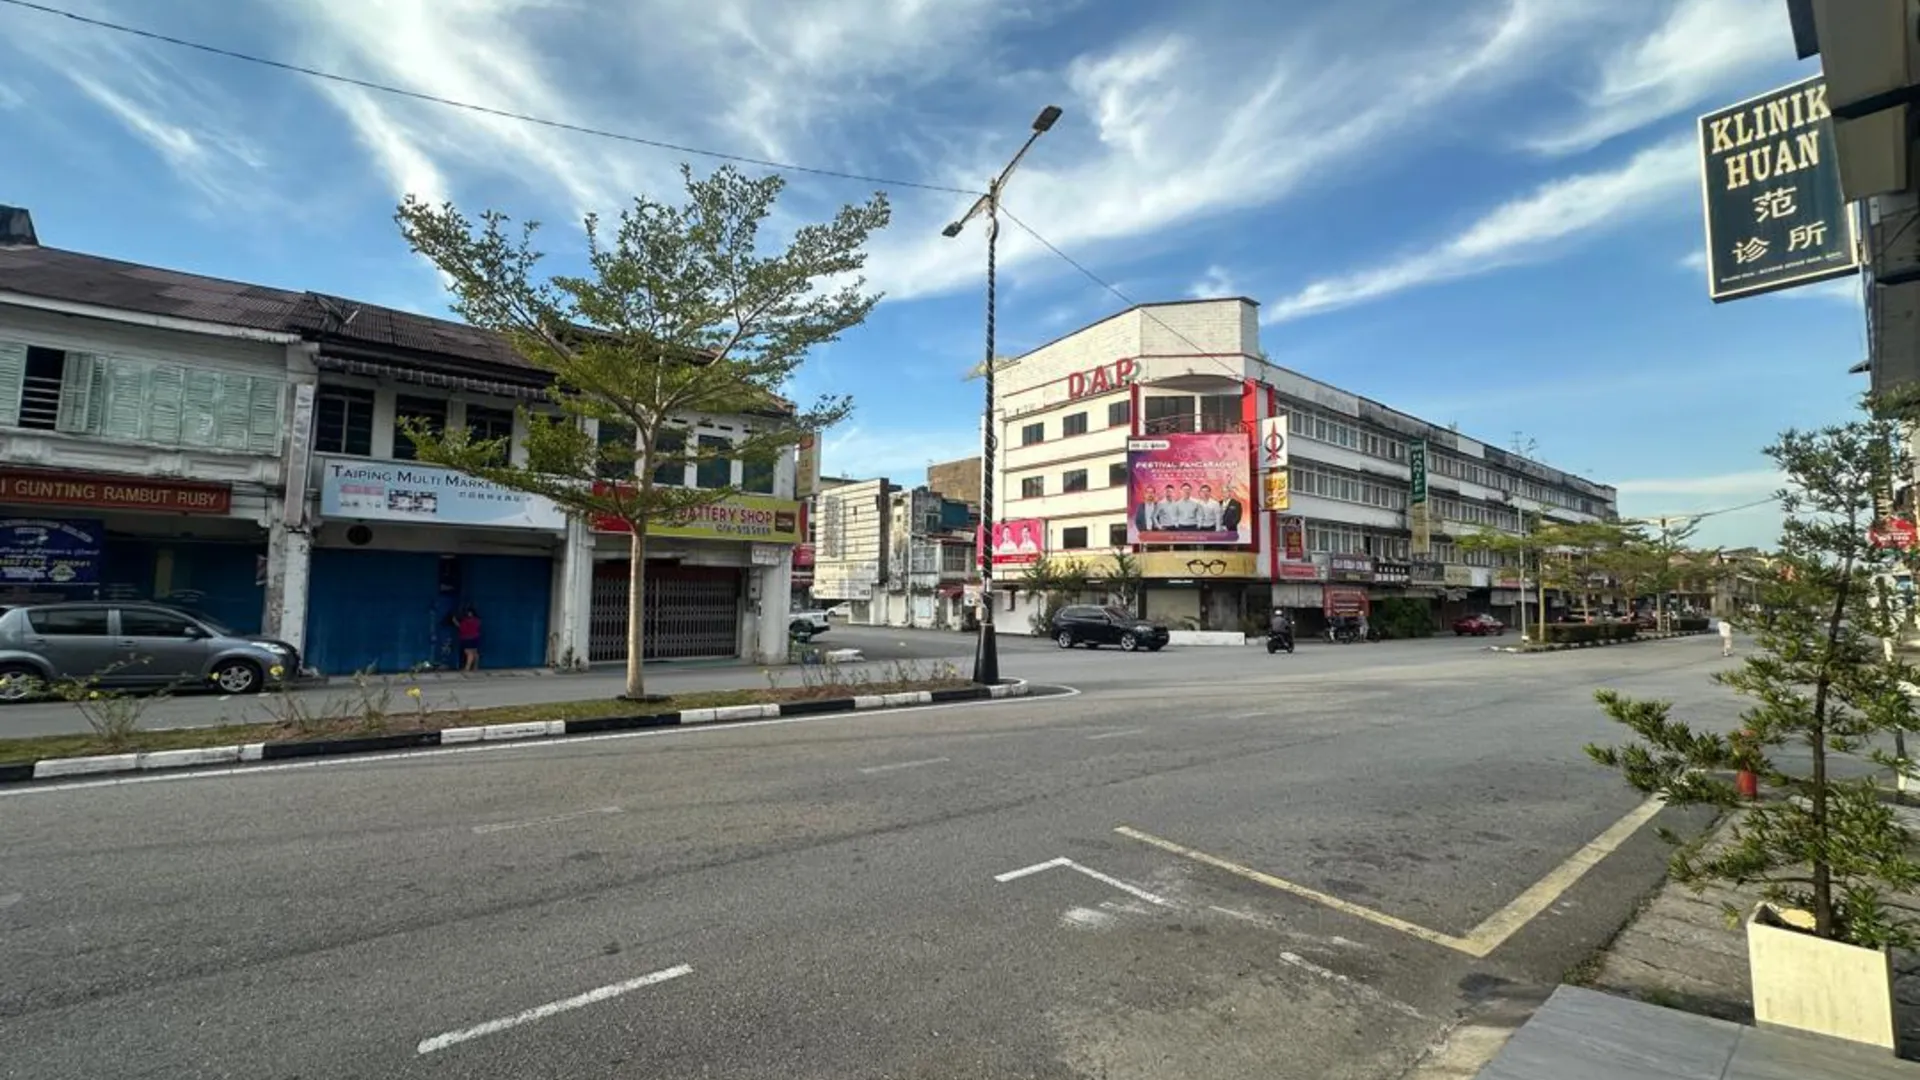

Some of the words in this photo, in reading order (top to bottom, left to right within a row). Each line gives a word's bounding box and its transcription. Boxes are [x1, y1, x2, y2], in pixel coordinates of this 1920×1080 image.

[1709, 83, 1832, 155] KLINIK
[1725, 130, 1819, 190] HUAN
[1752, 186, 1797, 222] 范
[1068, 357, 1134, 400] DAP
[15, 480, 97, 499] GUNTING
[103, 486, 171, 504] RAMBUT
[177, 491, 217, 506] RUBY
[331, 464, 392, 482] TAIPING
[397, 470, 440, 486] MULTI
[678, 504, 737, 522] BATTERY
[740, 509, 773, 524] SHOP
